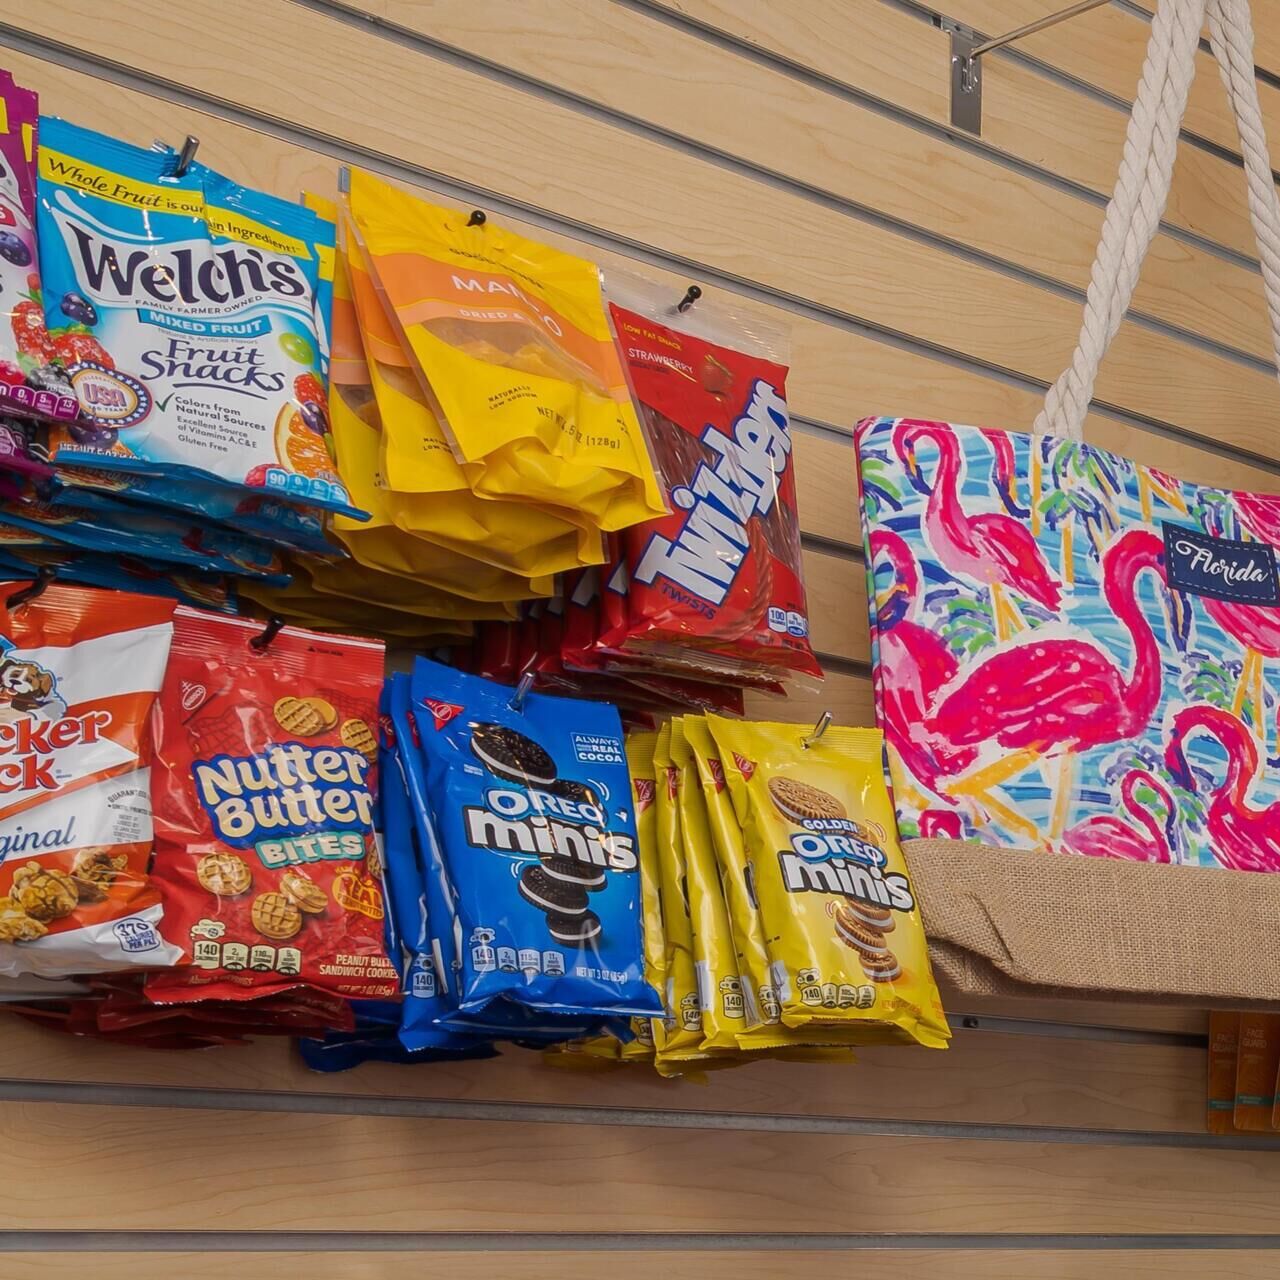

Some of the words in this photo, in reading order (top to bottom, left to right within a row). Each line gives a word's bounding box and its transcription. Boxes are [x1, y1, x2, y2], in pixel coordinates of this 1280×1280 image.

[47, 157, 108, 193] Whole
[111, 183, 162, 209] Fruit
[166, 197, 178, 209] is
[180, 201, 204, 215] our
[207, 219, 225, 233] ain
[64, 221, 305, 306] Welch's
[135, 299, 174, 312] FAMILY
[177, 305, 221, 316] FARMER
[223, 294, 264, 313] OWNED
[451, 274, 563, 338] MANO
[150, 310, 206, 333] MIXED
[211, 318, 264, 336] FRUIT
[623, 323, 641, 336] LOW
[167, 338, 265, 366] Fruit
[628, 347, 694, 375] STRAWBERRY
[140, 350, 285, 394] Snacks
[174, 396, 212, 411] Colors
[213, 404, 242, 417] from
[175, 403, 222, 422] Natural
[224, 414, 267, 432] Sources
[177, 415, 217, 431] Excellent
[219, 424, 249, 438] Source
[177, 423, 190, 434] of
[190, 425, 228, 443] Vitamins
[229, 433, 258, 449] A,C&E
[177, 434, 207, 448] Gluten
[209, 441, 228, 452] Free
[269, 472, 285, 486] 90
[1174, 538, 1269, 585] Florida
[661, 583, 717, 620] TWISTS
[575, 735, 620, 746] ALWAYS
[592, 744, 621, 754] REAL
[578, 752, 623, 763] COCOA
[196, 745, 367, 805] Nutter
[215, 785, 373, 837] Butter
[488, 790, 604, 823] OREO
[803, 819, 858, 832] GOLDEN
[261, 835, 363, 864] BITES
[467, 808, 637, 870] minis
[794, 835, 883, 861] OREO
[782, 853, 913, 909] minis
[117, 923, 149, 936] 370
[197, 944, 217, 955] 140
[336, 954, 369, 967] PEANUT
[319, 965, 364, 976] SANDWICH
[415, 974, 433, 986] 140
[803, 987, 820, 1000] 140
